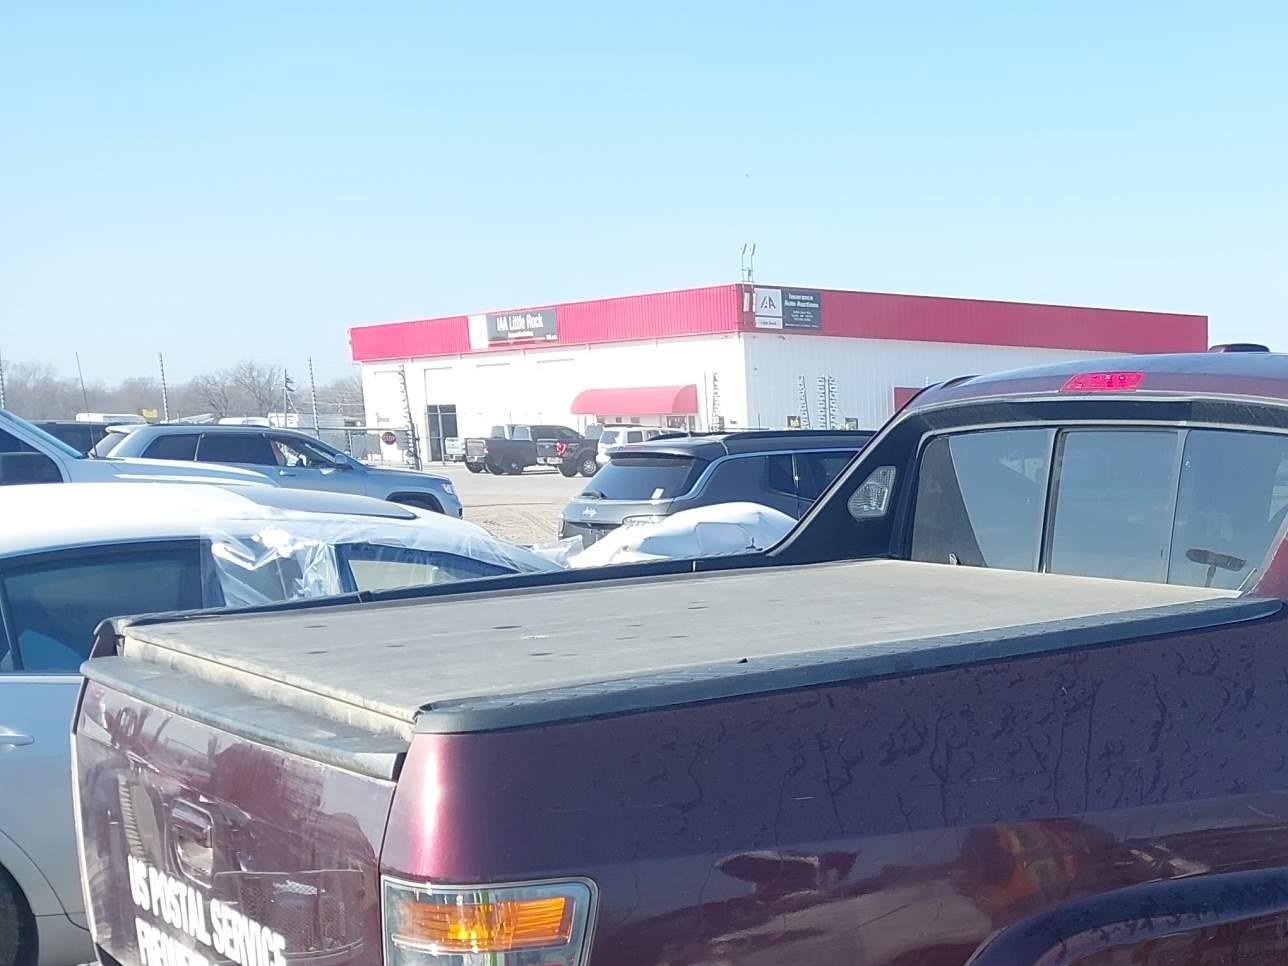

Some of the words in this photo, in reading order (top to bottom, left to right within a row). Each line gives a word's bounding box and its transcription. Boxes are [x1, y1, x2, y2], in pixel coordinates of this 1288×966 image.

[496, 316, 508, 331] IAA
[508, 314, 526, 331] Little
[526, 313, 544, 329] Rock
[128, 854, 150, 911] US
[149, 866, 212, 946] POSTAL
